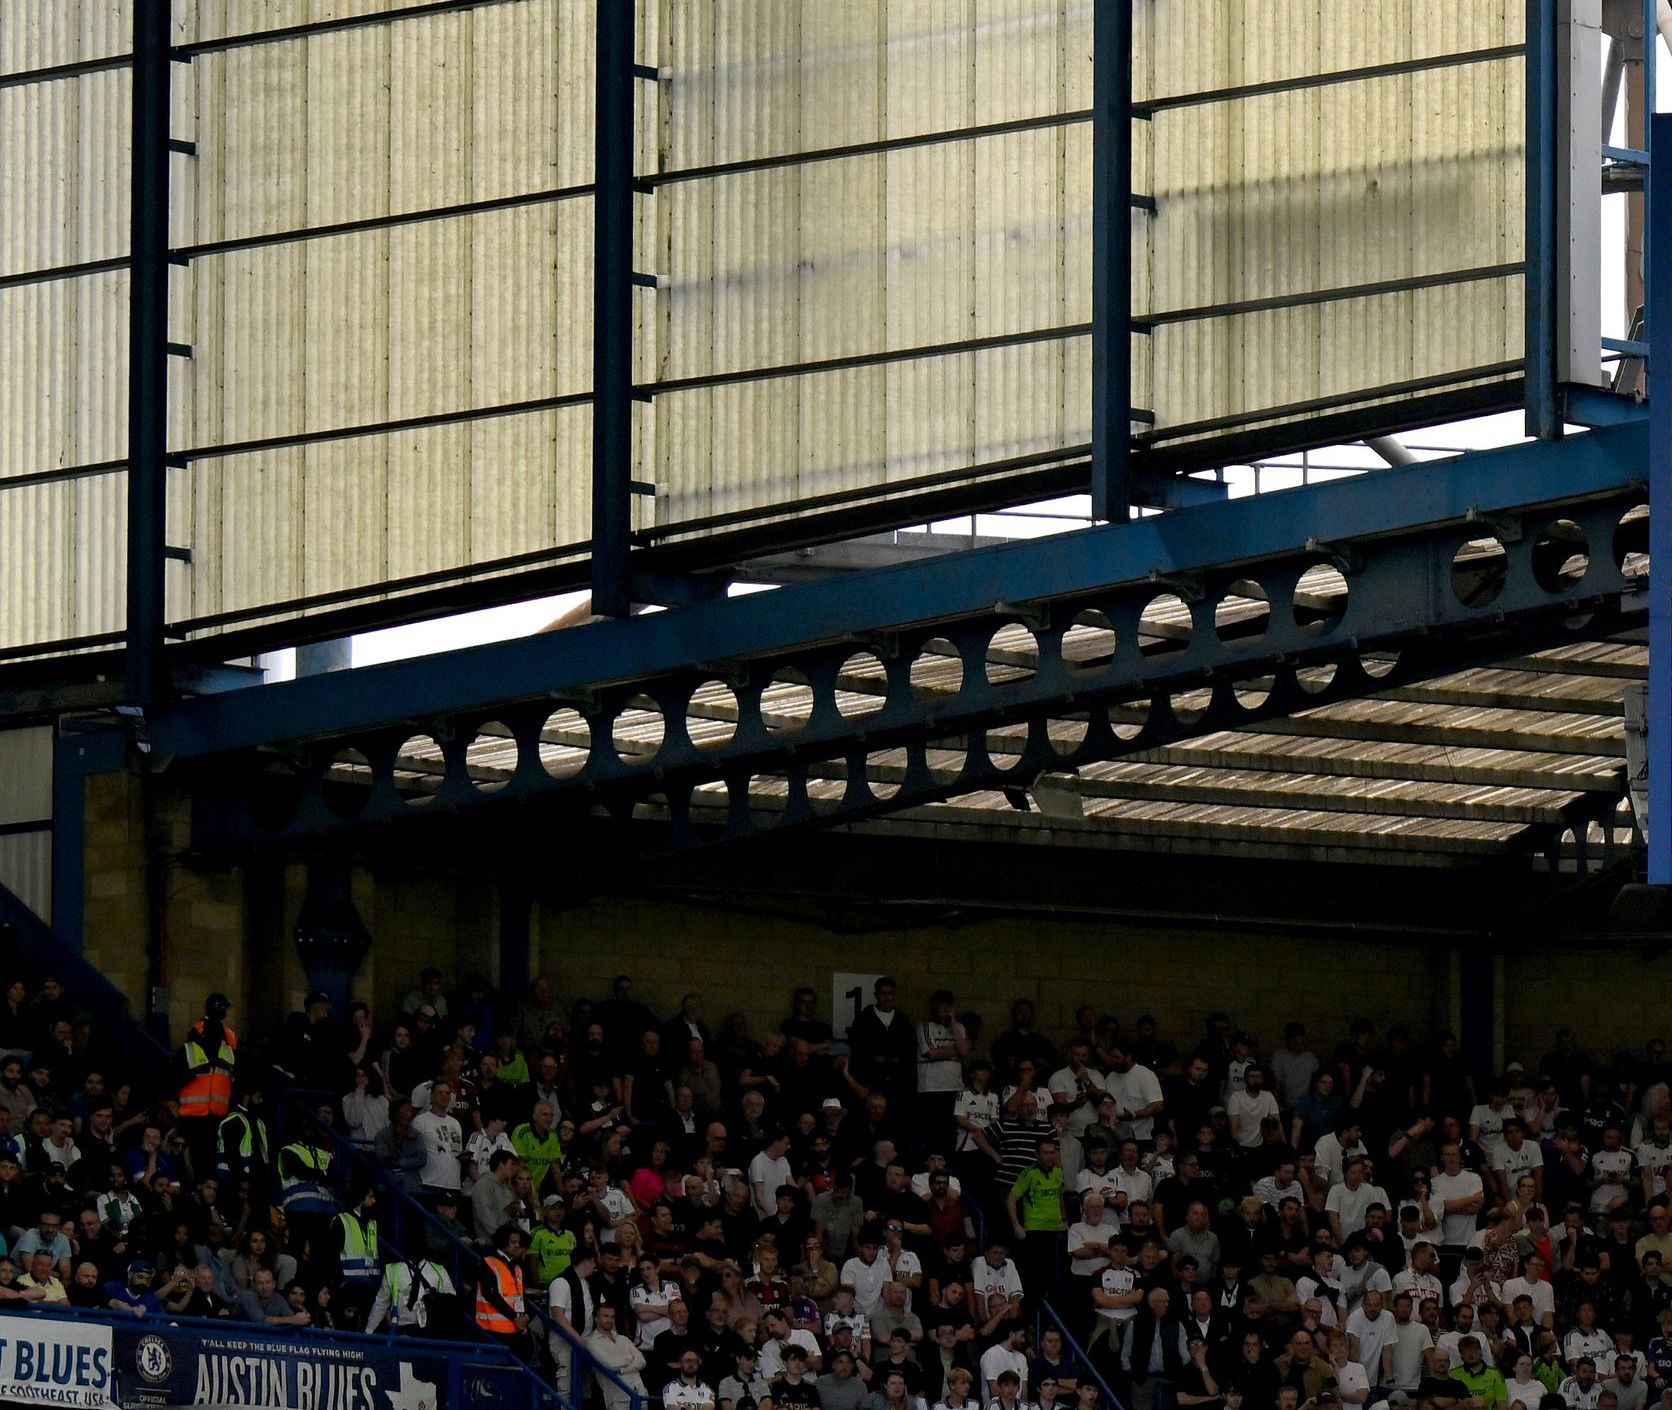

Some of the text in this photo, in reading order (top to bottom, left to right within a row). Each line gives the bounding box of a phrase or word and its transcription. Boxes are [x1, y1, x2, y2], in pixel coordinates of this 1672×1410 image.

[13, 1339, 108, 1389] BLUES
[227, 1340, 248, 1350] KEEP
[250, 1342, 265, 1351] THE
[266, 1343, 287, 1353] BLUE
[289, 1345, 310, 1355] FLAG
[312, 1347, 340, 1358] FLYING
[342, 1350, 364, 1360] HIGH!
[193, 1353, 288, 1409] AUSTIN
